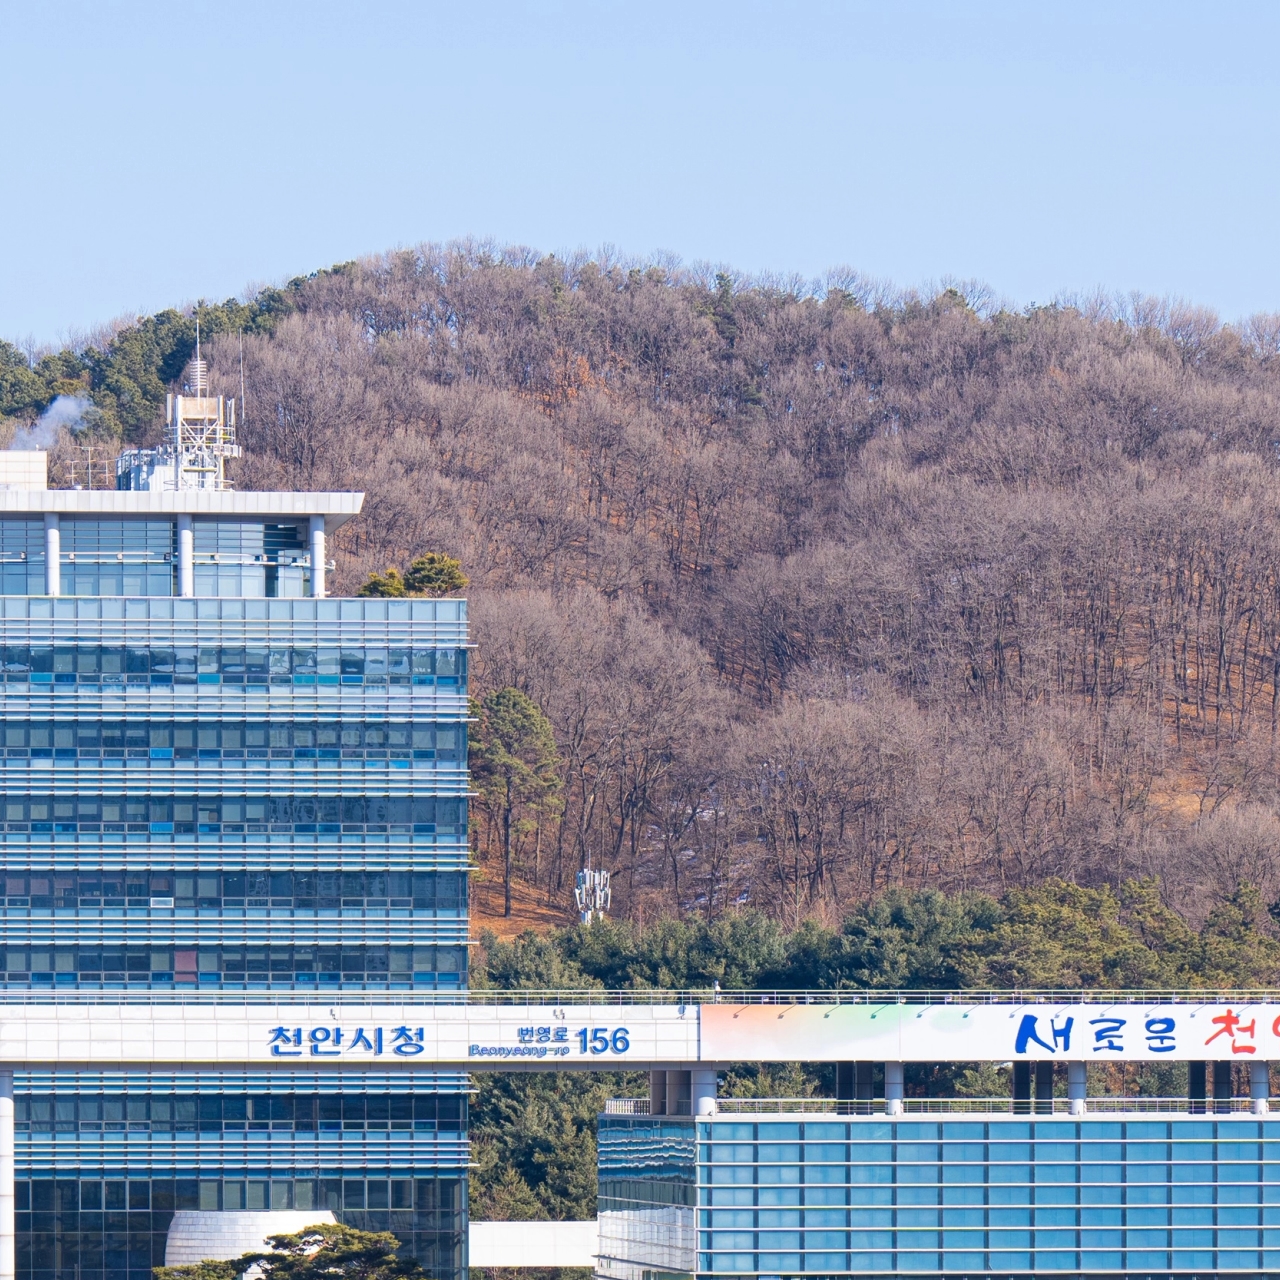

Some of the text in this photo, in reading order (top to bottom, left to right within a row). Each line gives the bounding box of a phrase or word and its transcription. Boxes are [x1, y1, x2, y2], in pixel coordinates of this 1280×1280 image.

[267, 1026, 426, 1057] 천안시청
[518, 1026, 630, 1054] 번영로 156
[1014, 1013, 1176, 1053] 새로운
[469, 1044, 570, 1058] Beonyeong-ro
